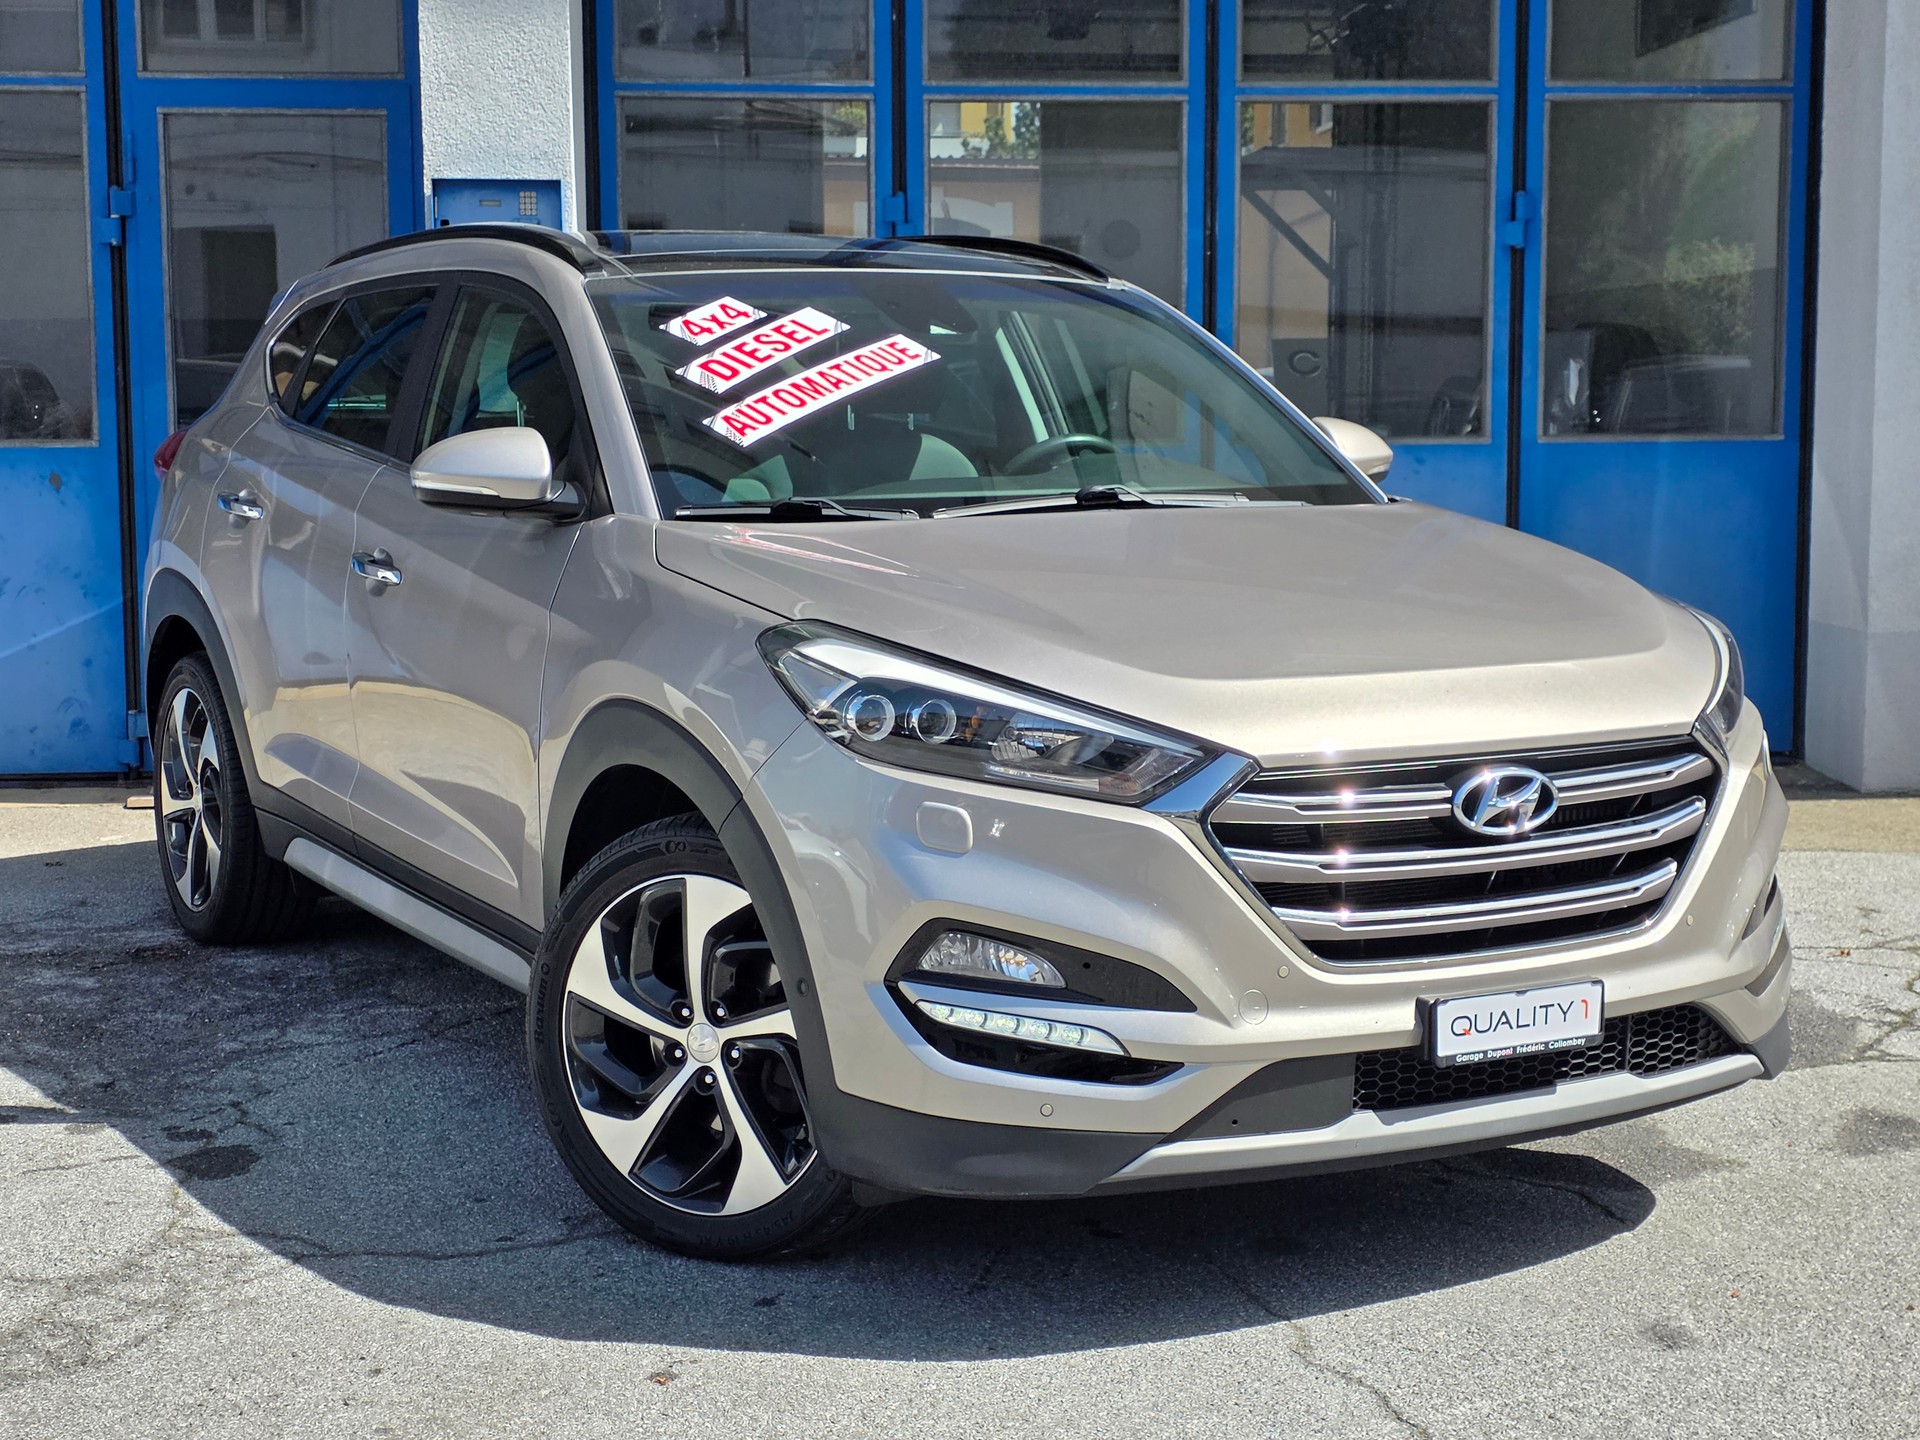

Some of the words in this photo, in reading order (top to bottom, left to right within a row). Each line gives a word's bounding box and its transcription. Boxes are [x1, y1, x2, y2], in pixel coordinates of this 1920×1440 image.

[682, 303, 752, 337] 4x4
[698, 319, 829, 382] DIESEL
[721, 341, 921, 437] AUTOMATIQUE
[1450, 1000, 1574, 1037] QUALITY
[1581, 999, 1589, 1019] 1
[1456, 1053, 1484, 1064] Garage
[1487, 1047, 1513, 1060] Dupont
[1516, 1042, 1545, 1054] Frédéric
[1548, 1037, 1586, 1049] Collombey
